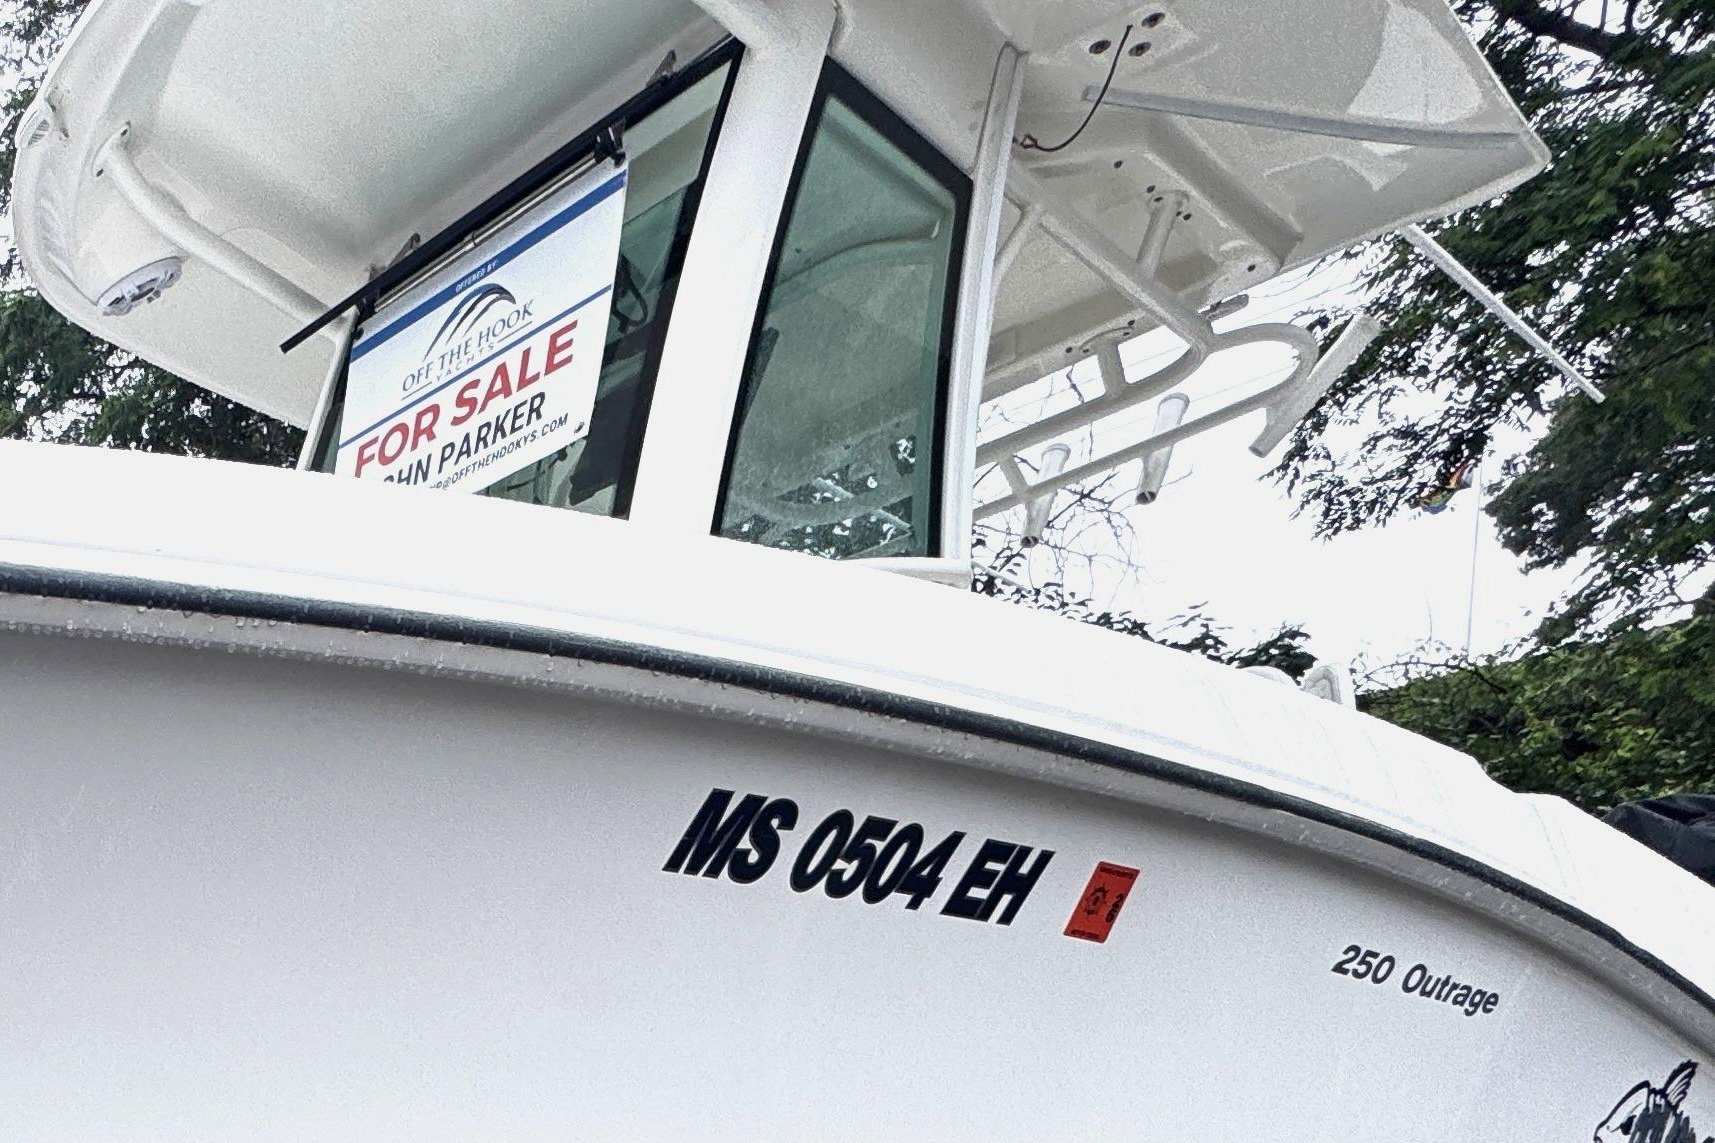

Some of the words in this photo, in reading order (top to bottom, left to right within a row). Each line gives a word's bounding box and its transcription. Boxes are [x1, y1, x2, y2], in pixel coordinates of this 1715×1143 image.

[402, 360, 434, 392] OFF
[439, 338, 472, 367] THE
[478, 299, 534, 345] HOOK
[435, 342, 495, 383] YACHTS
[355, 403, 441, 479] FOR
[451, 319, 578, 427] SALE
[438, 391, 546, 475] PARKER
[662, 788, 799, 884] MS
[789, 808, 967, 911] 0504
[939, 838, 1057, 926] EH
[1331, 944, 1396, 985] 250
[1401, 963, 1500, 1017] Outrage
